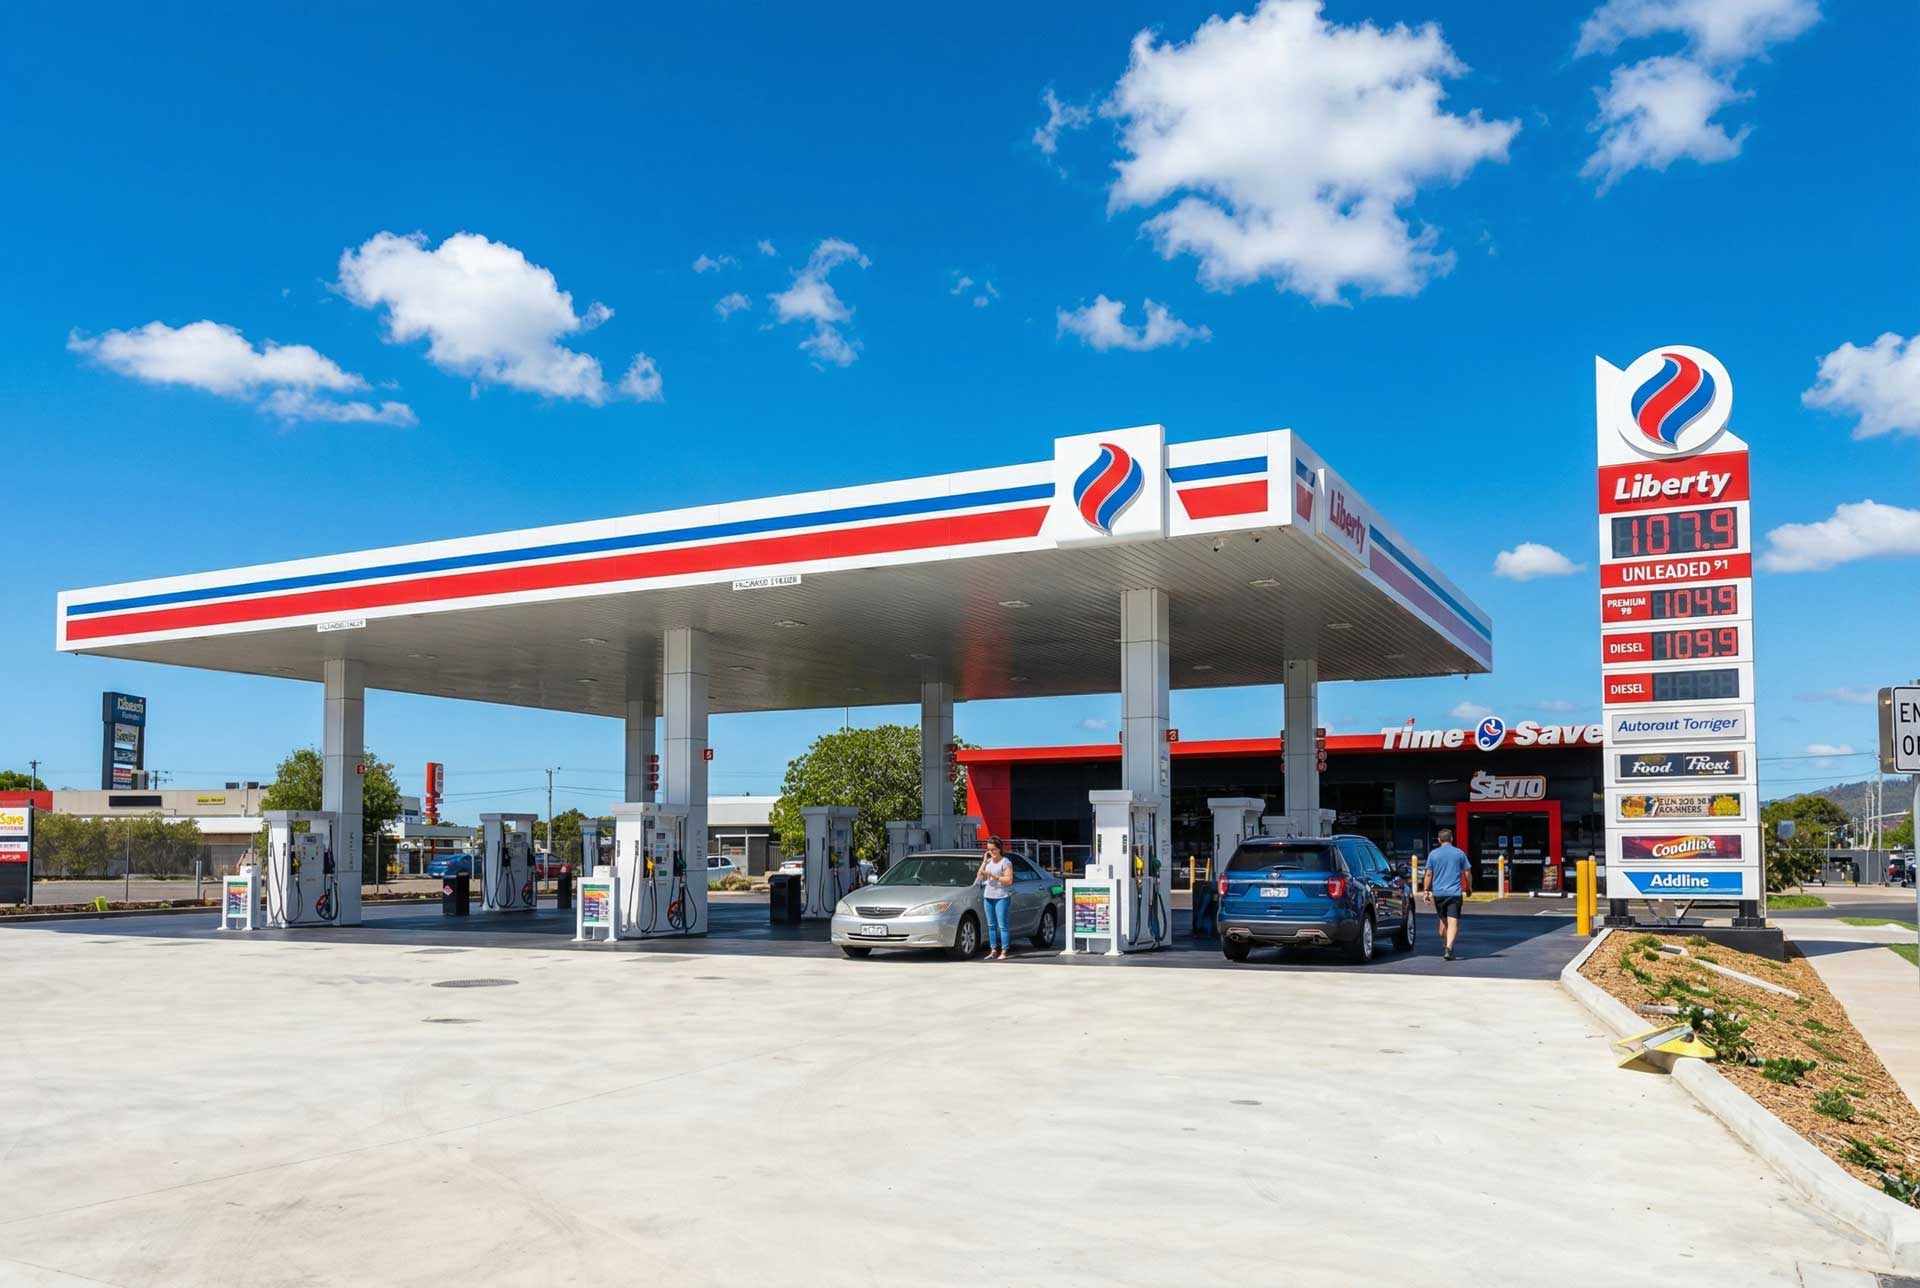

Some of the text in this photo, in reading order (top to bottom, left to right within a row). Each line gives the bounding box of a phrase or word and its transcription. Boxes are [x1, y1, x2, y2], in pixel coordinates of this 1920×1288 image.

[1614, 471, 1731, 500] Liberty
[1330, 489, 1366, 555] Liberty
[1631, 509, 1735, 556] 107.9
[1622, 559, 1728, 582] UNLEADED 91
[1607, 598, 1646, 608] PREMIUM
[1621, 607, 1632, 615] 98
[1664, 586, 1738, 618] 104.9
[1610, 642, 1645, 654] DIESEL
[1665, 628, 1738, 659] 109.9
[1611, 684, 1645, 695] DIESEL
[1381, 718, 1603, 749] Time Save
[1632, 761, 1672, 774] Food
[1650, 874, 1710, 887] Addline
